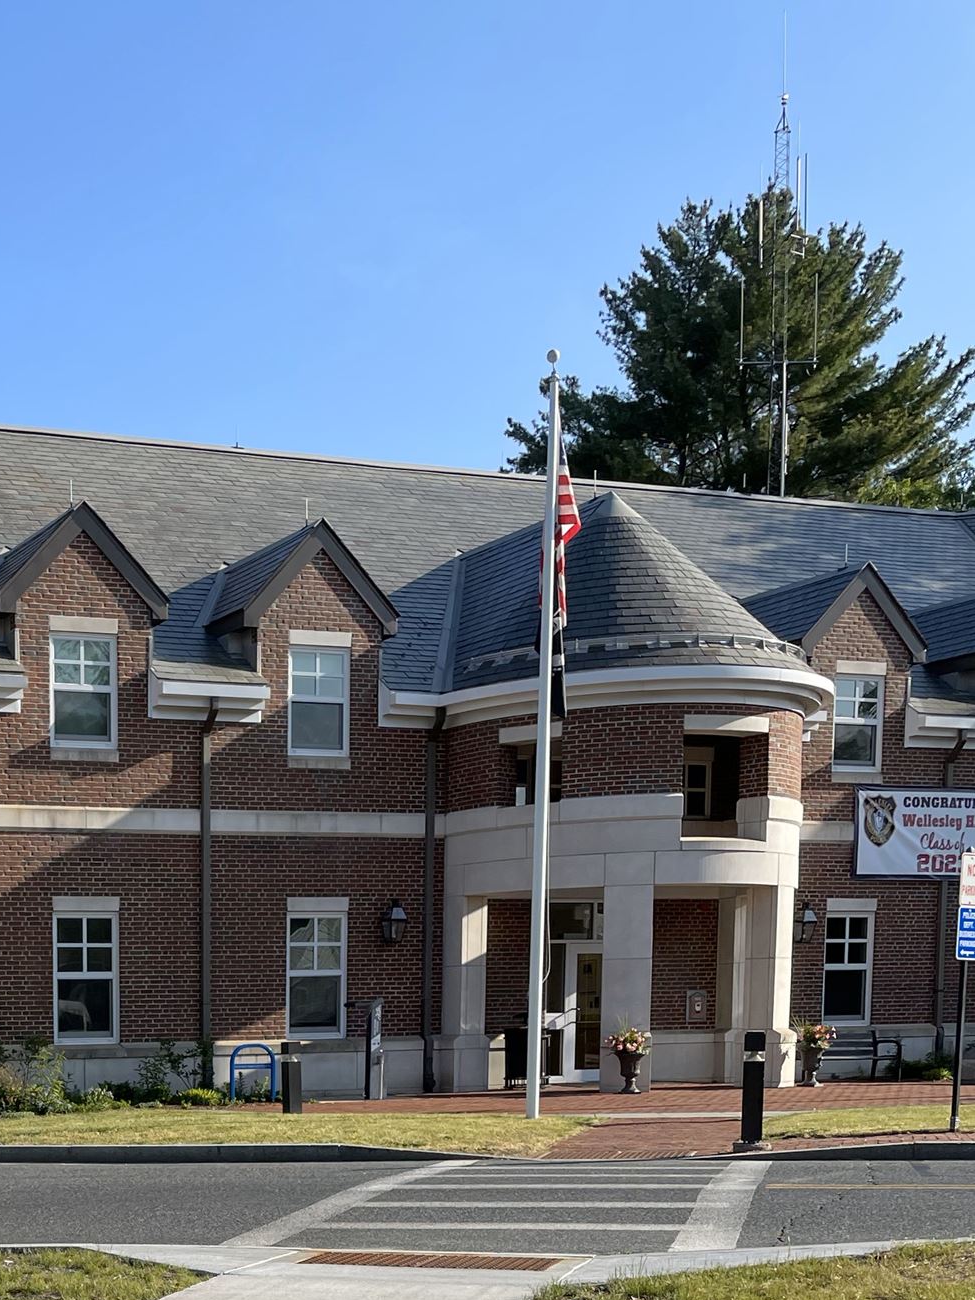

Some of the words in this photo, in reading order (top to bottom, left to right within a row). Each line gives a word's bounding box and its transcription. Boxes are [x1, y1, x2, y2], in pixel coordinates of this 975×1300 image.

[902, 814, 962, 831] Wellesley
[966, 814, 975, 828] H
[920, 831, 953, 850] Class
[955, 832, 965, 856] of
